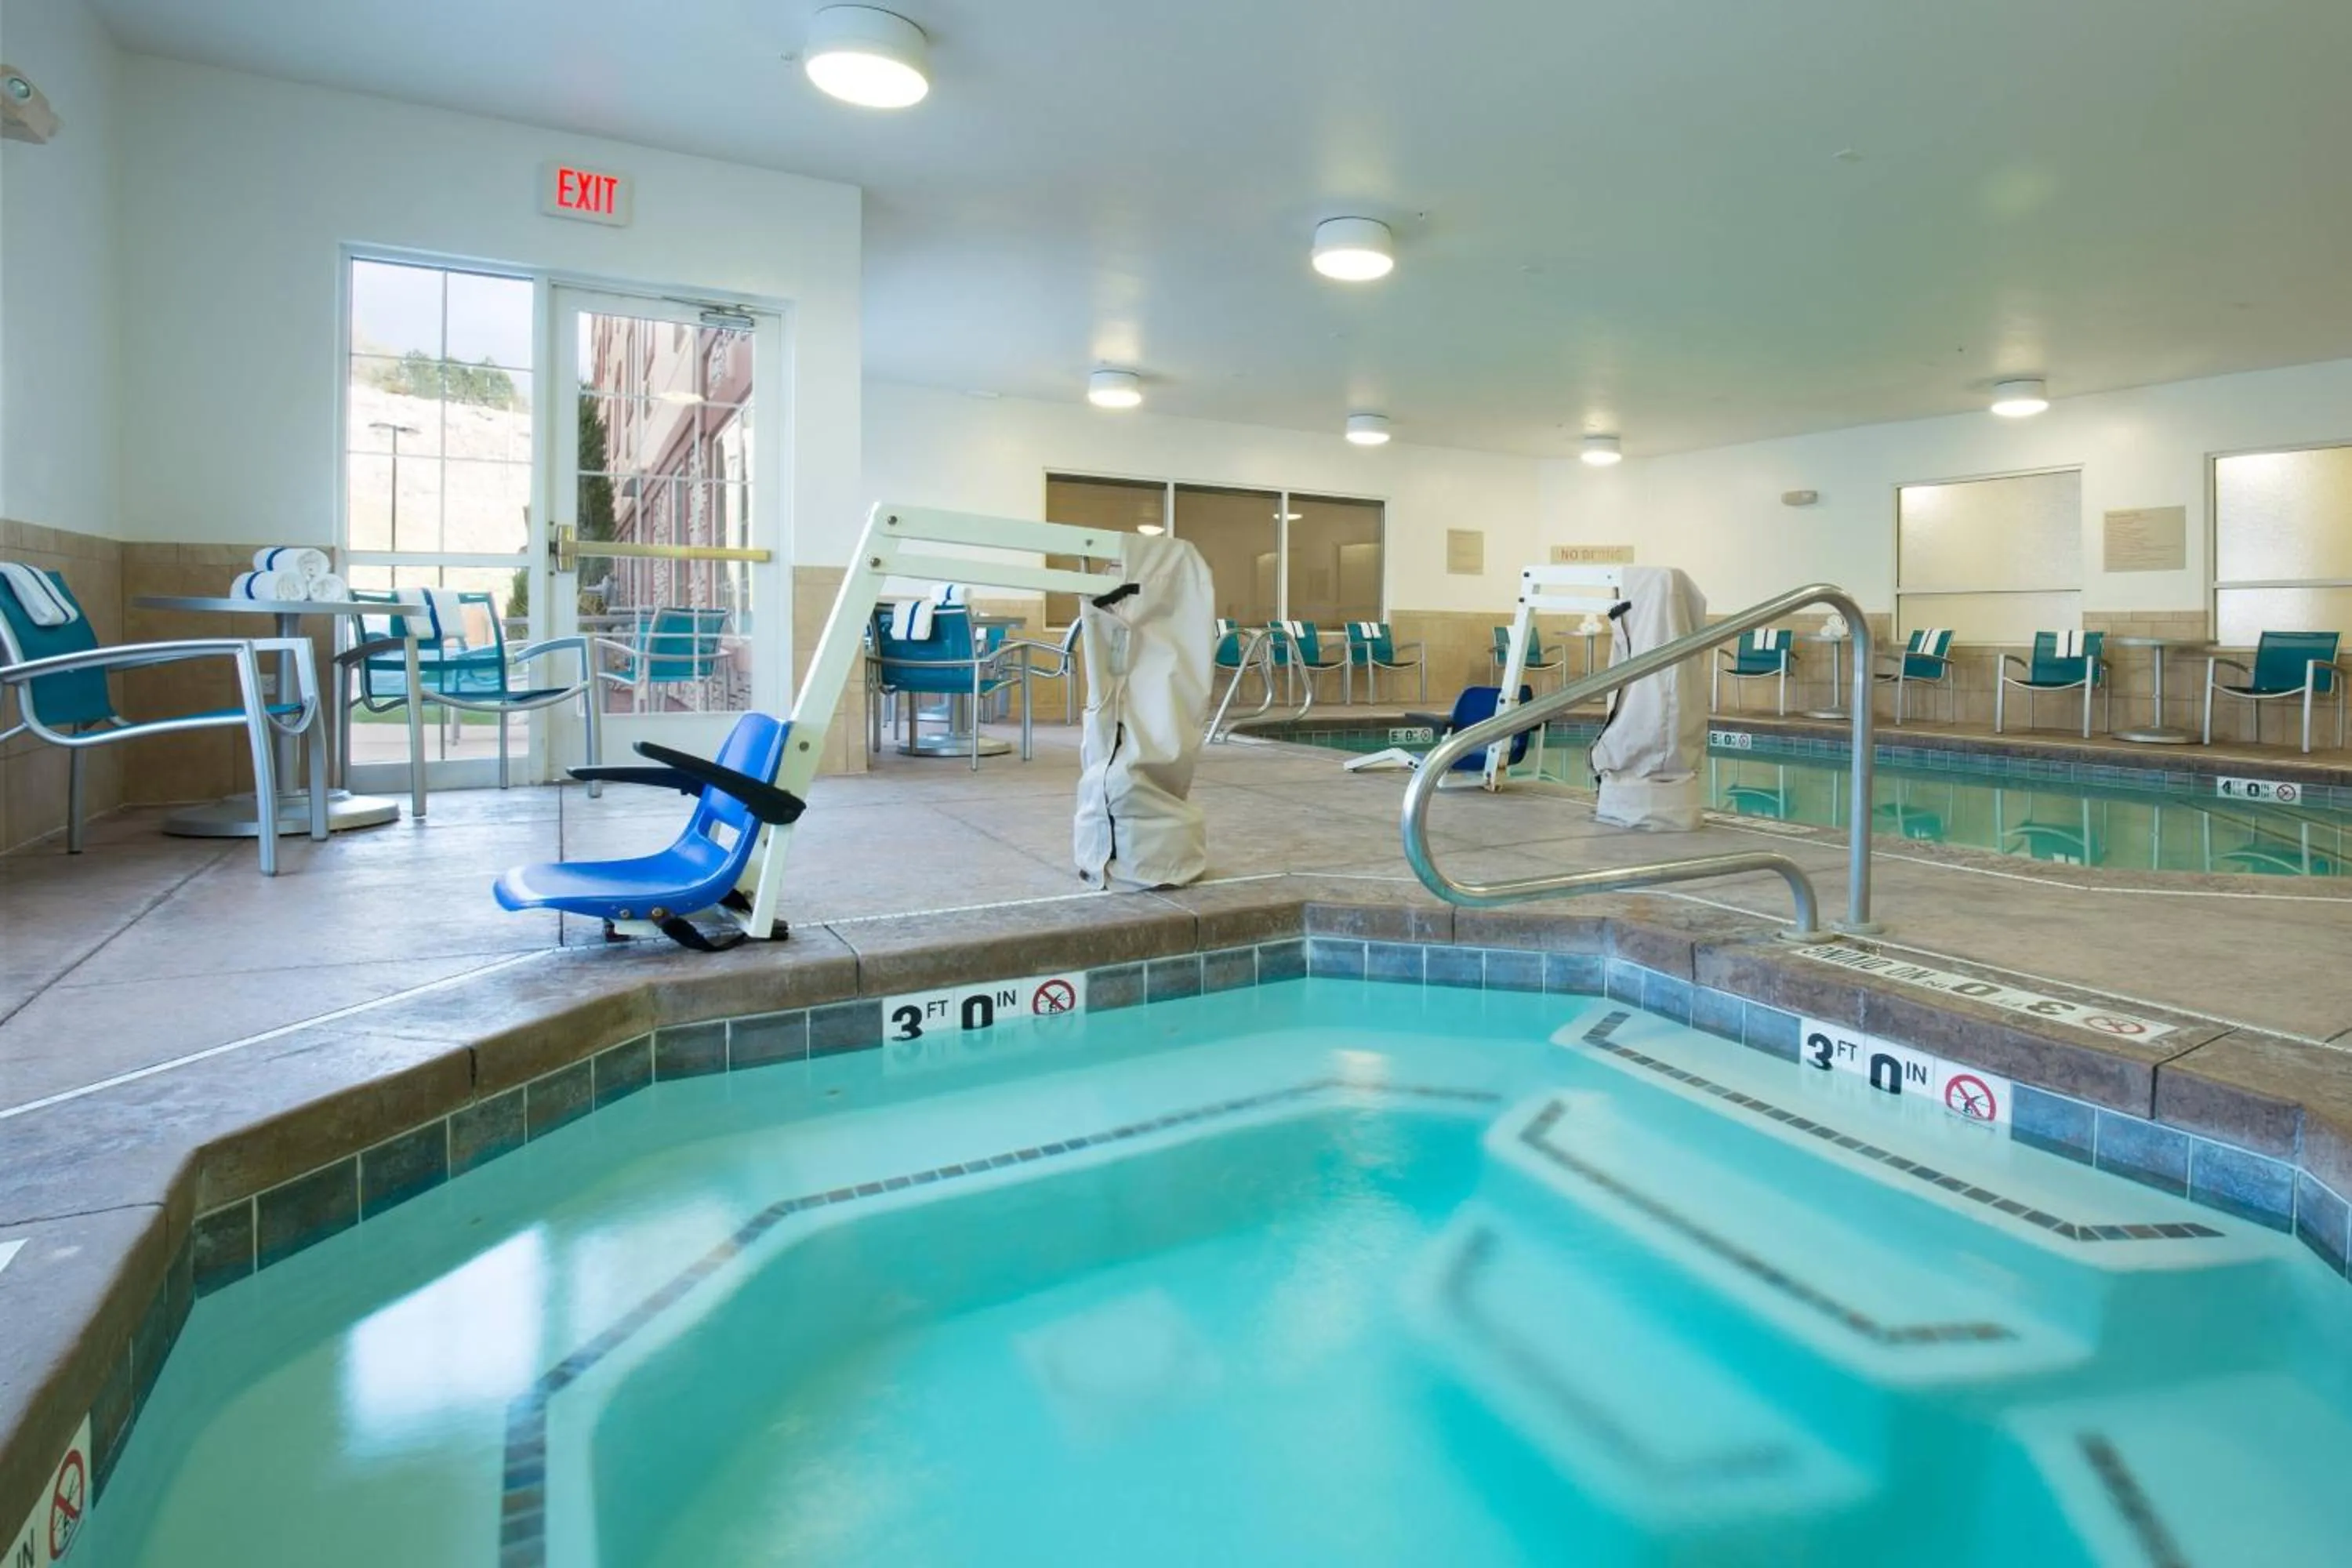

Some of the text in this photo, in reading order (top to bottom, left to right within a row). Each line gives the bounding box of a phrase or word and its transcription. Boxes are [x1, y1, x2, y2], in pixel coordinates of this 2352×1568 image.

[557, 169, 618, 214] EXIT
[1561, 549, 1578, 560] NO
[1885, 967, 1936, 979] NO
